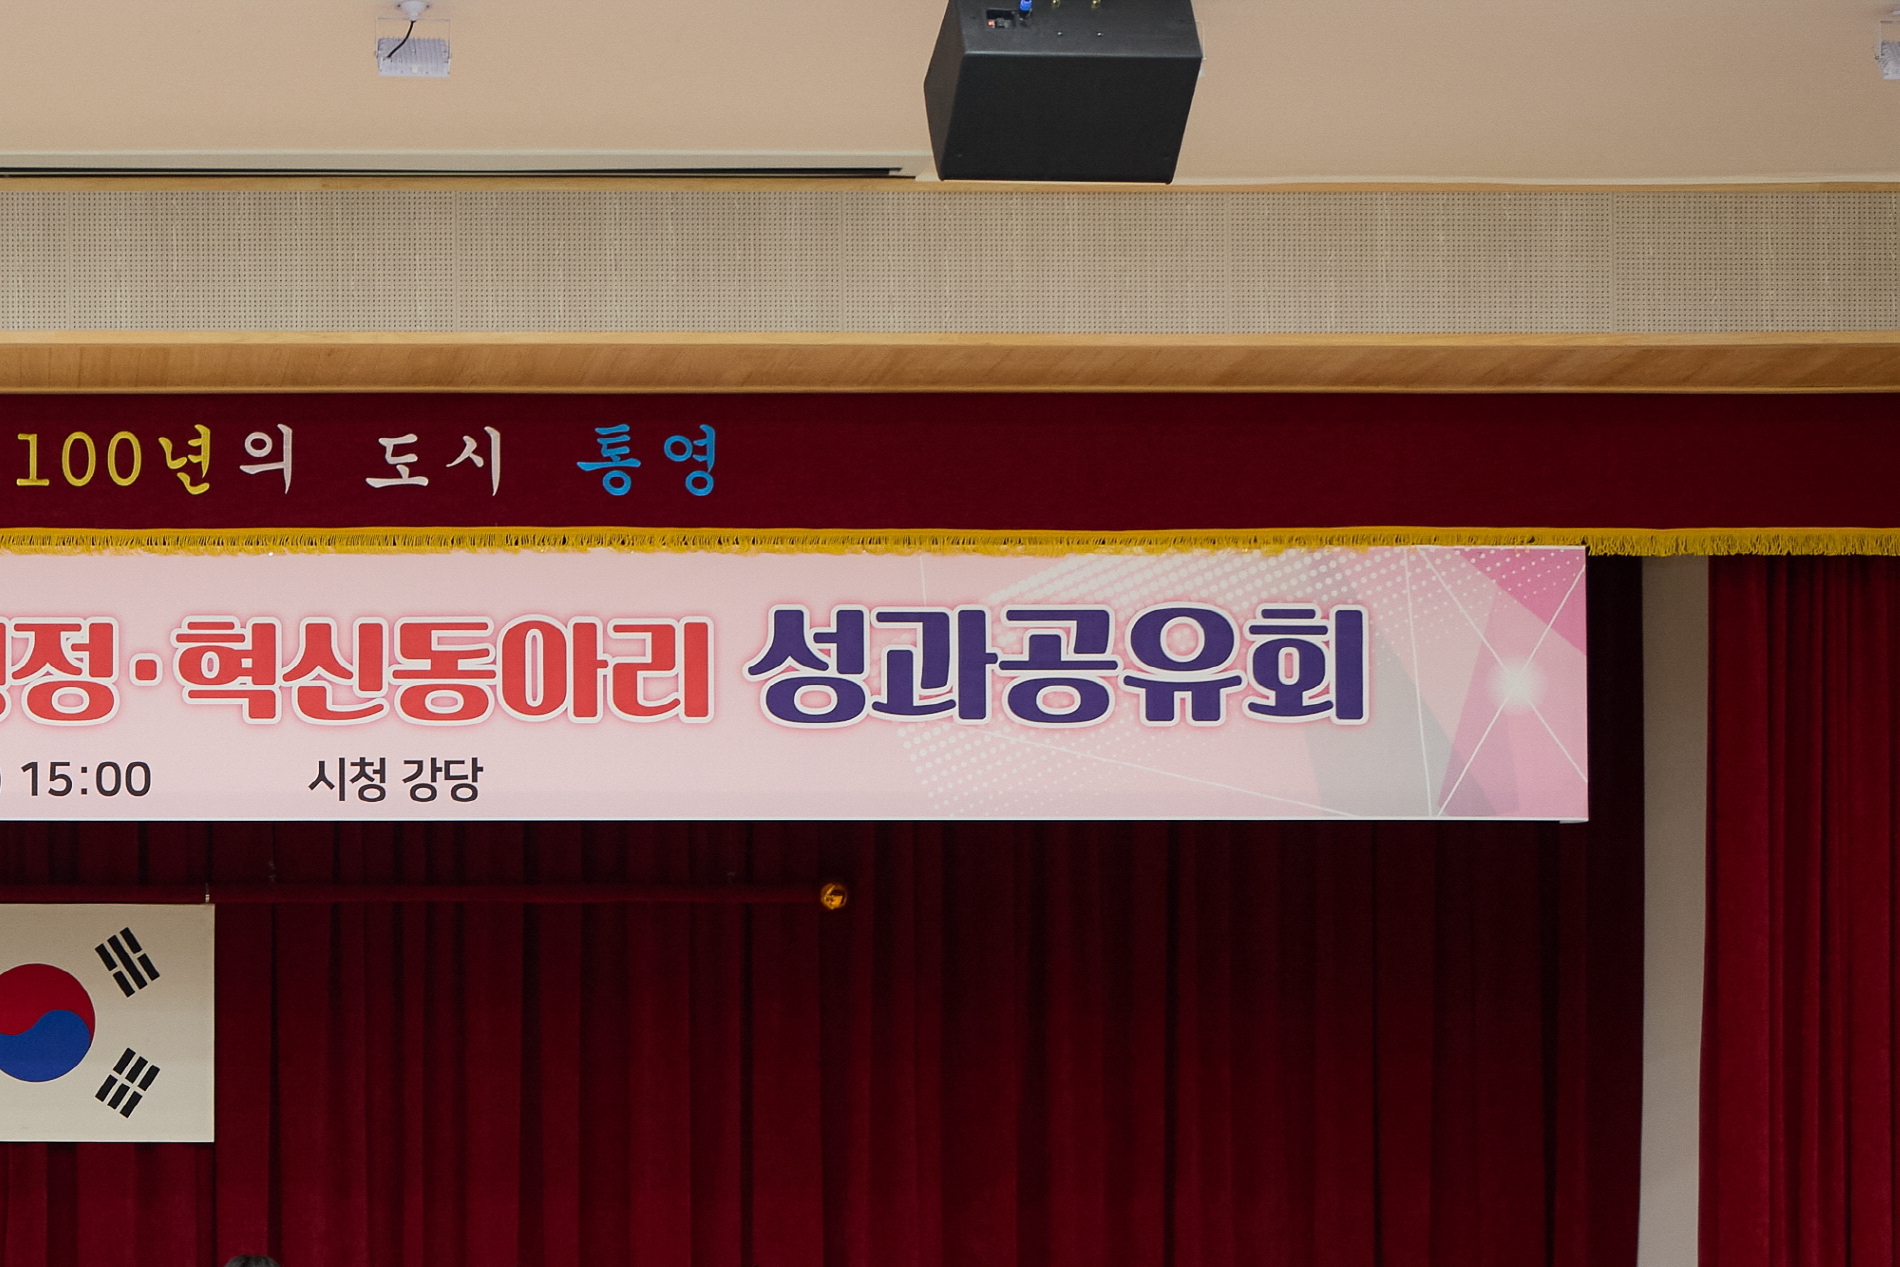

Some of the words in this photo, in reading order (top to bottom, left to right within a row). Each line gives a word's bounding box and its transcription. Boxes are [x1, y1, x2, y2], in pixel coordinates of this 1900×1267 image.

[16, 424, 293, 495] 100년의
[365, 425, 501, 497] 도시
[576, 423, 716, 497] 통영
[748, 607, 1364, 723] 성과공유회
[21, 761, 151, 797] 15:00
[308, 756, 386, 803] 시청
[402, 757, 484, 803] 강당
